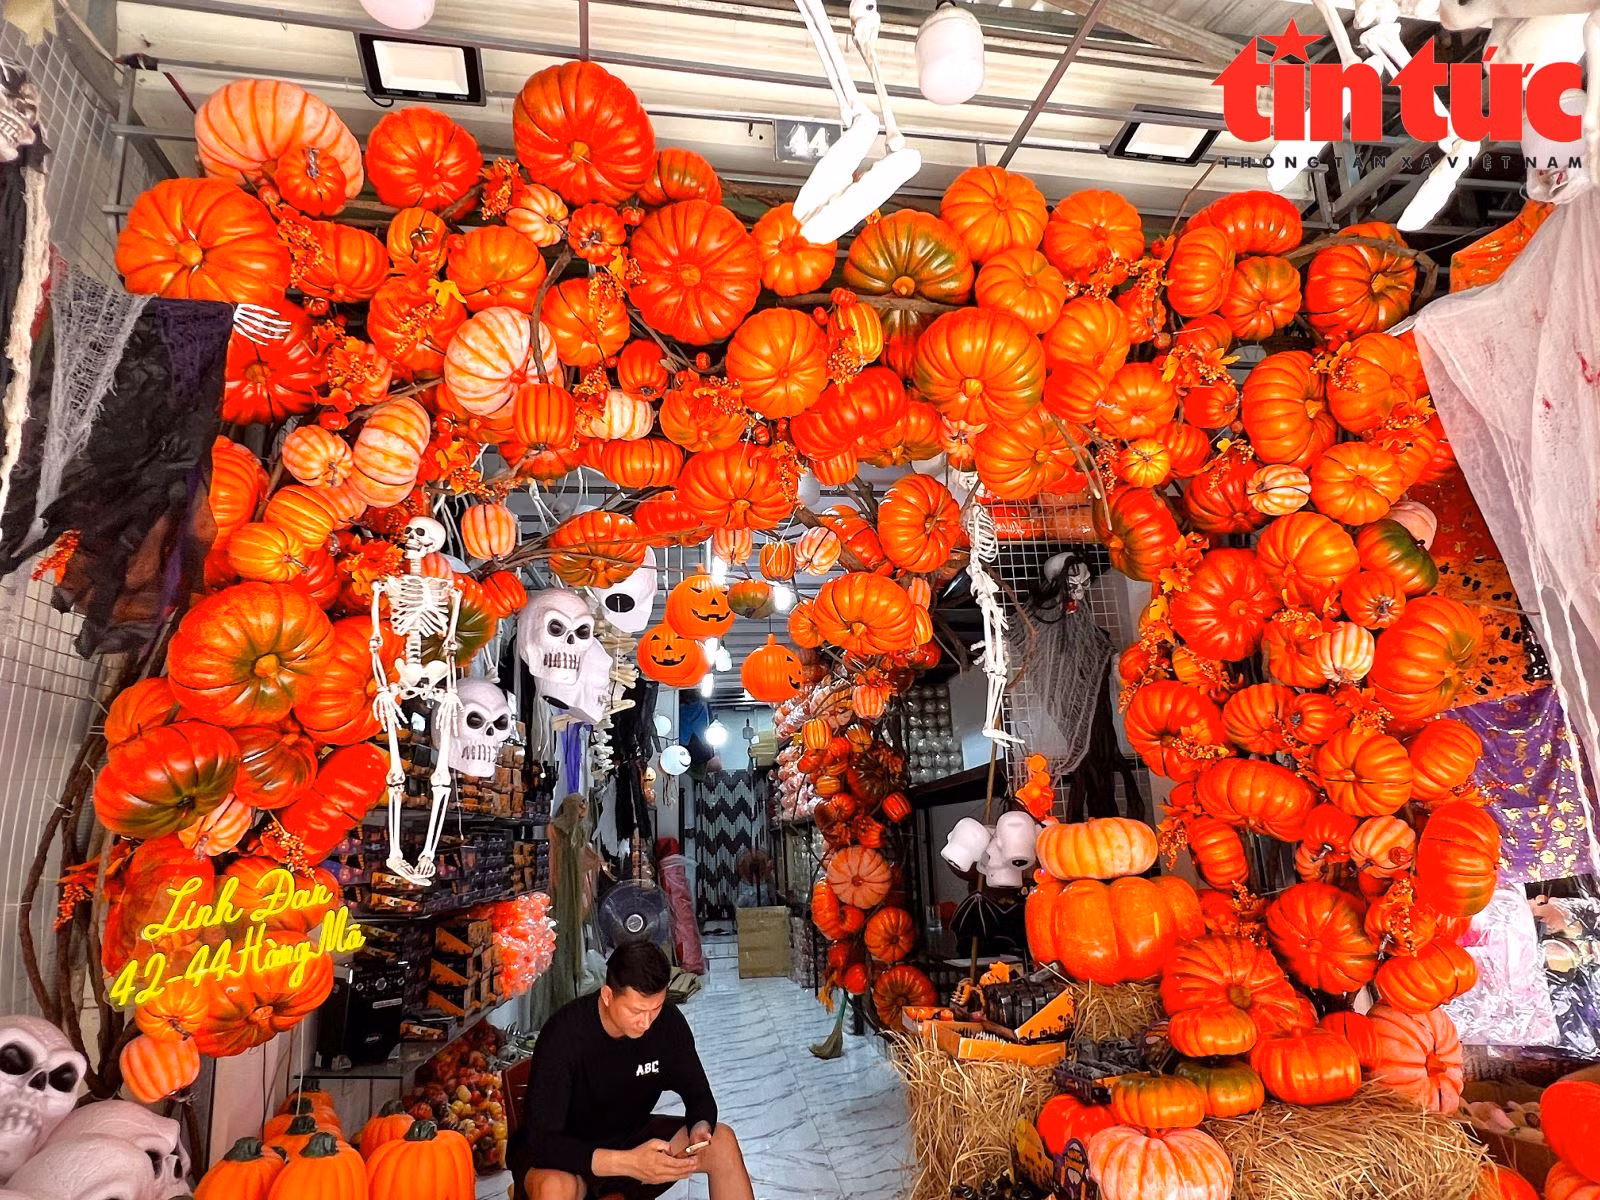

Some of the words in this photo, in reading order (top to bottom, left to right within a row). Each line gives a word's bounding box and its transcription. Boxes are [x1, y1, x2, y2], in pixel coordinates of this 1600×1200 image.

[142, 876, 245, 941] Linh
[250, 868, 334, 922] Đan
[230, 922, 312, 988] Hàng
[635, 1060, 660, 1077] ABC
